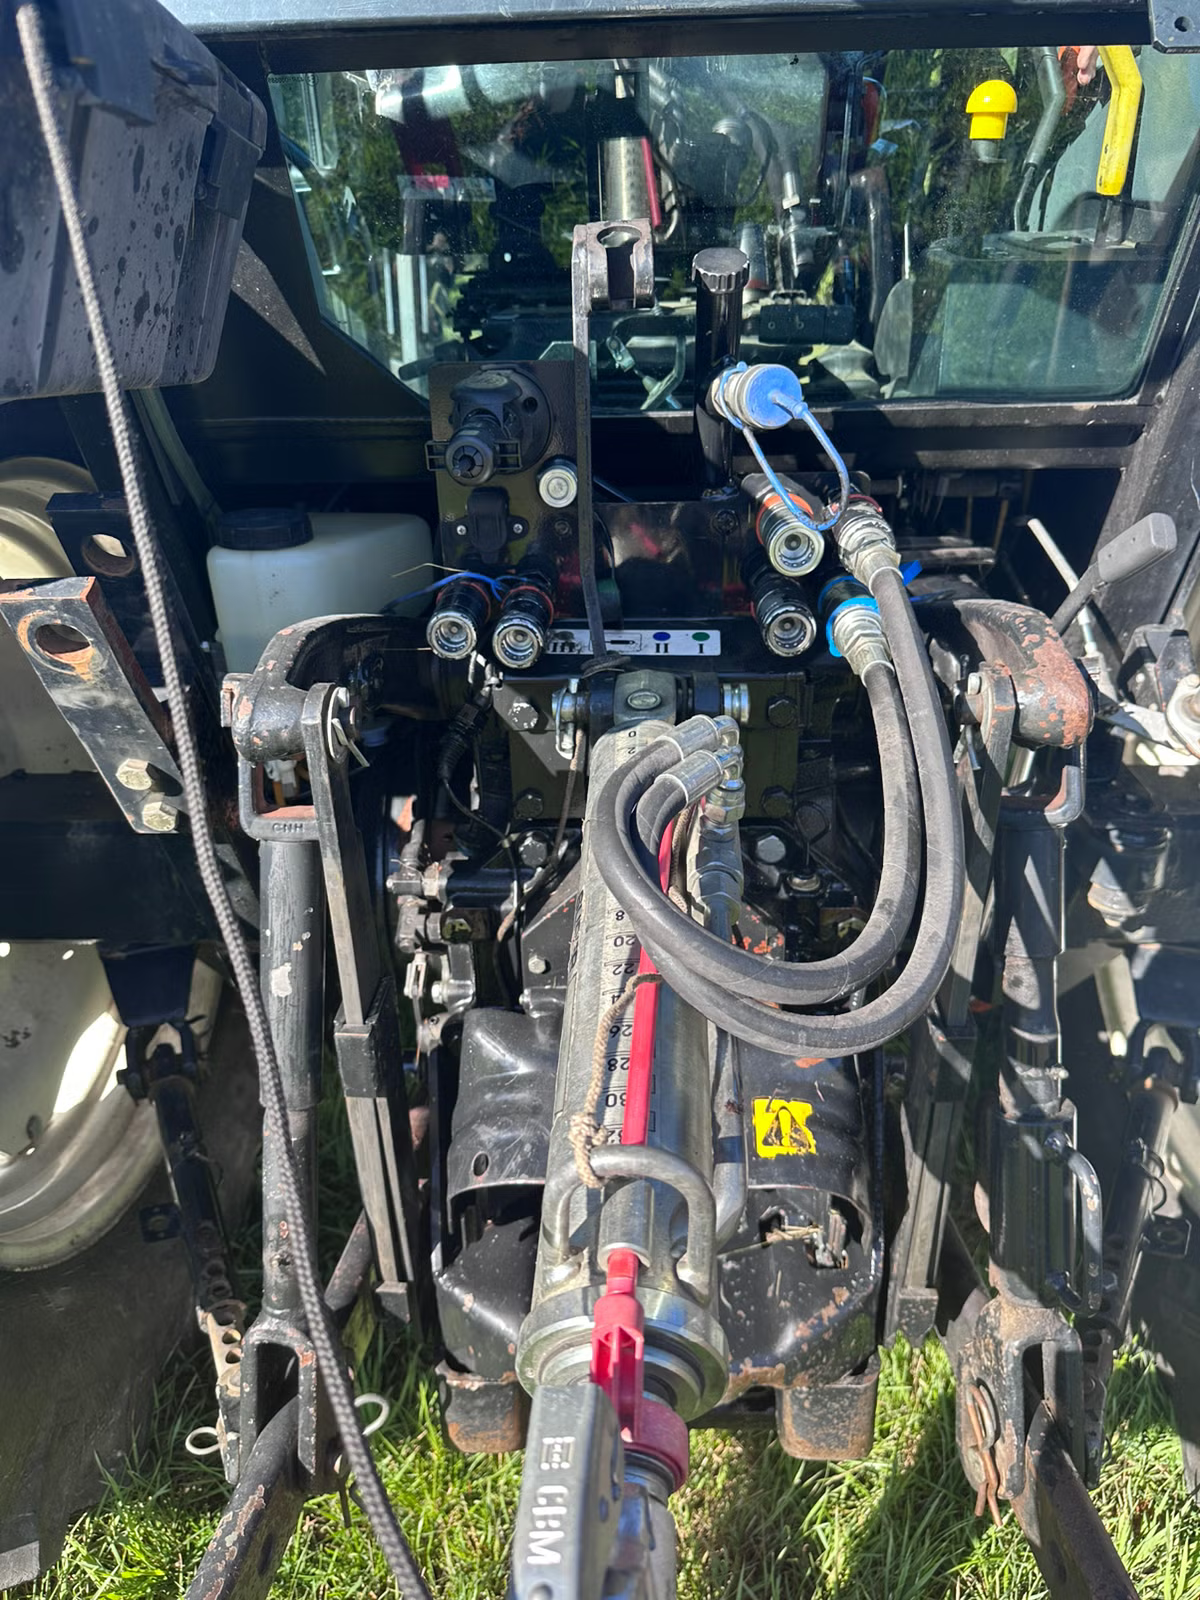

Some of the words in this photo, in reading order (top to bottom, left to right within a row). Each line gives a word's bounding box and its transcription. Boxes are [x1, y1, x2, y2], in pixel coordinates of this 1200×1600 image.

[655, 643, 669, 653] II
[698, 643, 704, 653] I
[272, 822, 305, 833] CNH
[613, 934, 636, 947] 20
[612, 963, 635, 976] 22
[609, 1024, 633, 1038] 26
[607, 1057, 630, 1072] 28
